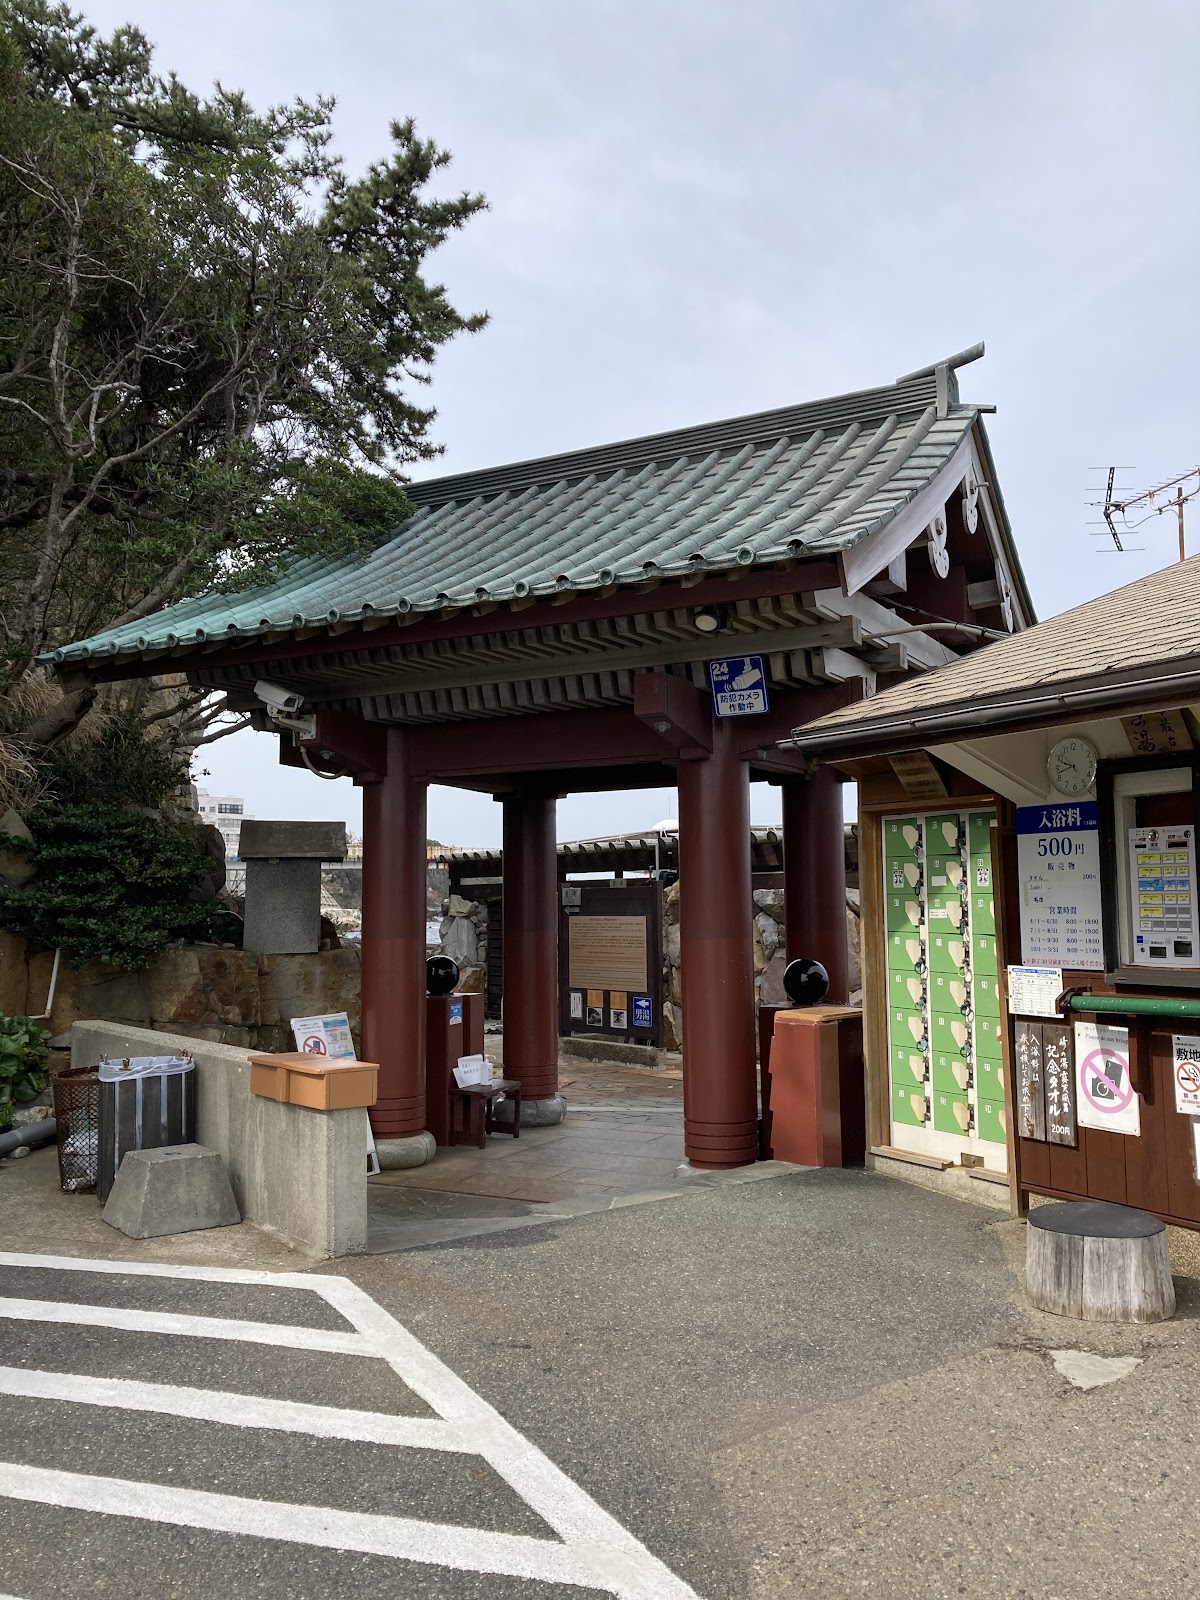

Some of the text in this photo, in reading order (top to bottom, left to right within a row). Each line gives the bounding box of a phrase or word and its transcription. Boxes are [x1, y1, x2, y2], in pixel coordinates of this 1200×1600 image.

[711, 662, 729, 675] 24
[720, 691, 760, 703] 防犯カメラ
[729, 702, 754, 712] 作動中
[1159, 712, 1177, 747] 最古
[1038, 807, 1082, 828] 入浴料
[1037, 837, 1084, 856] 500円
[1047, 862, 1075, 871] 販売物
[1049, 906, 1077, 914] 営業時間
[1030, 1034, 1041, 1082] 入浴料は
[1045, 1044, 1061, 1116] 記念タオル
[1051, 1124, 1071, 1136] 200円
